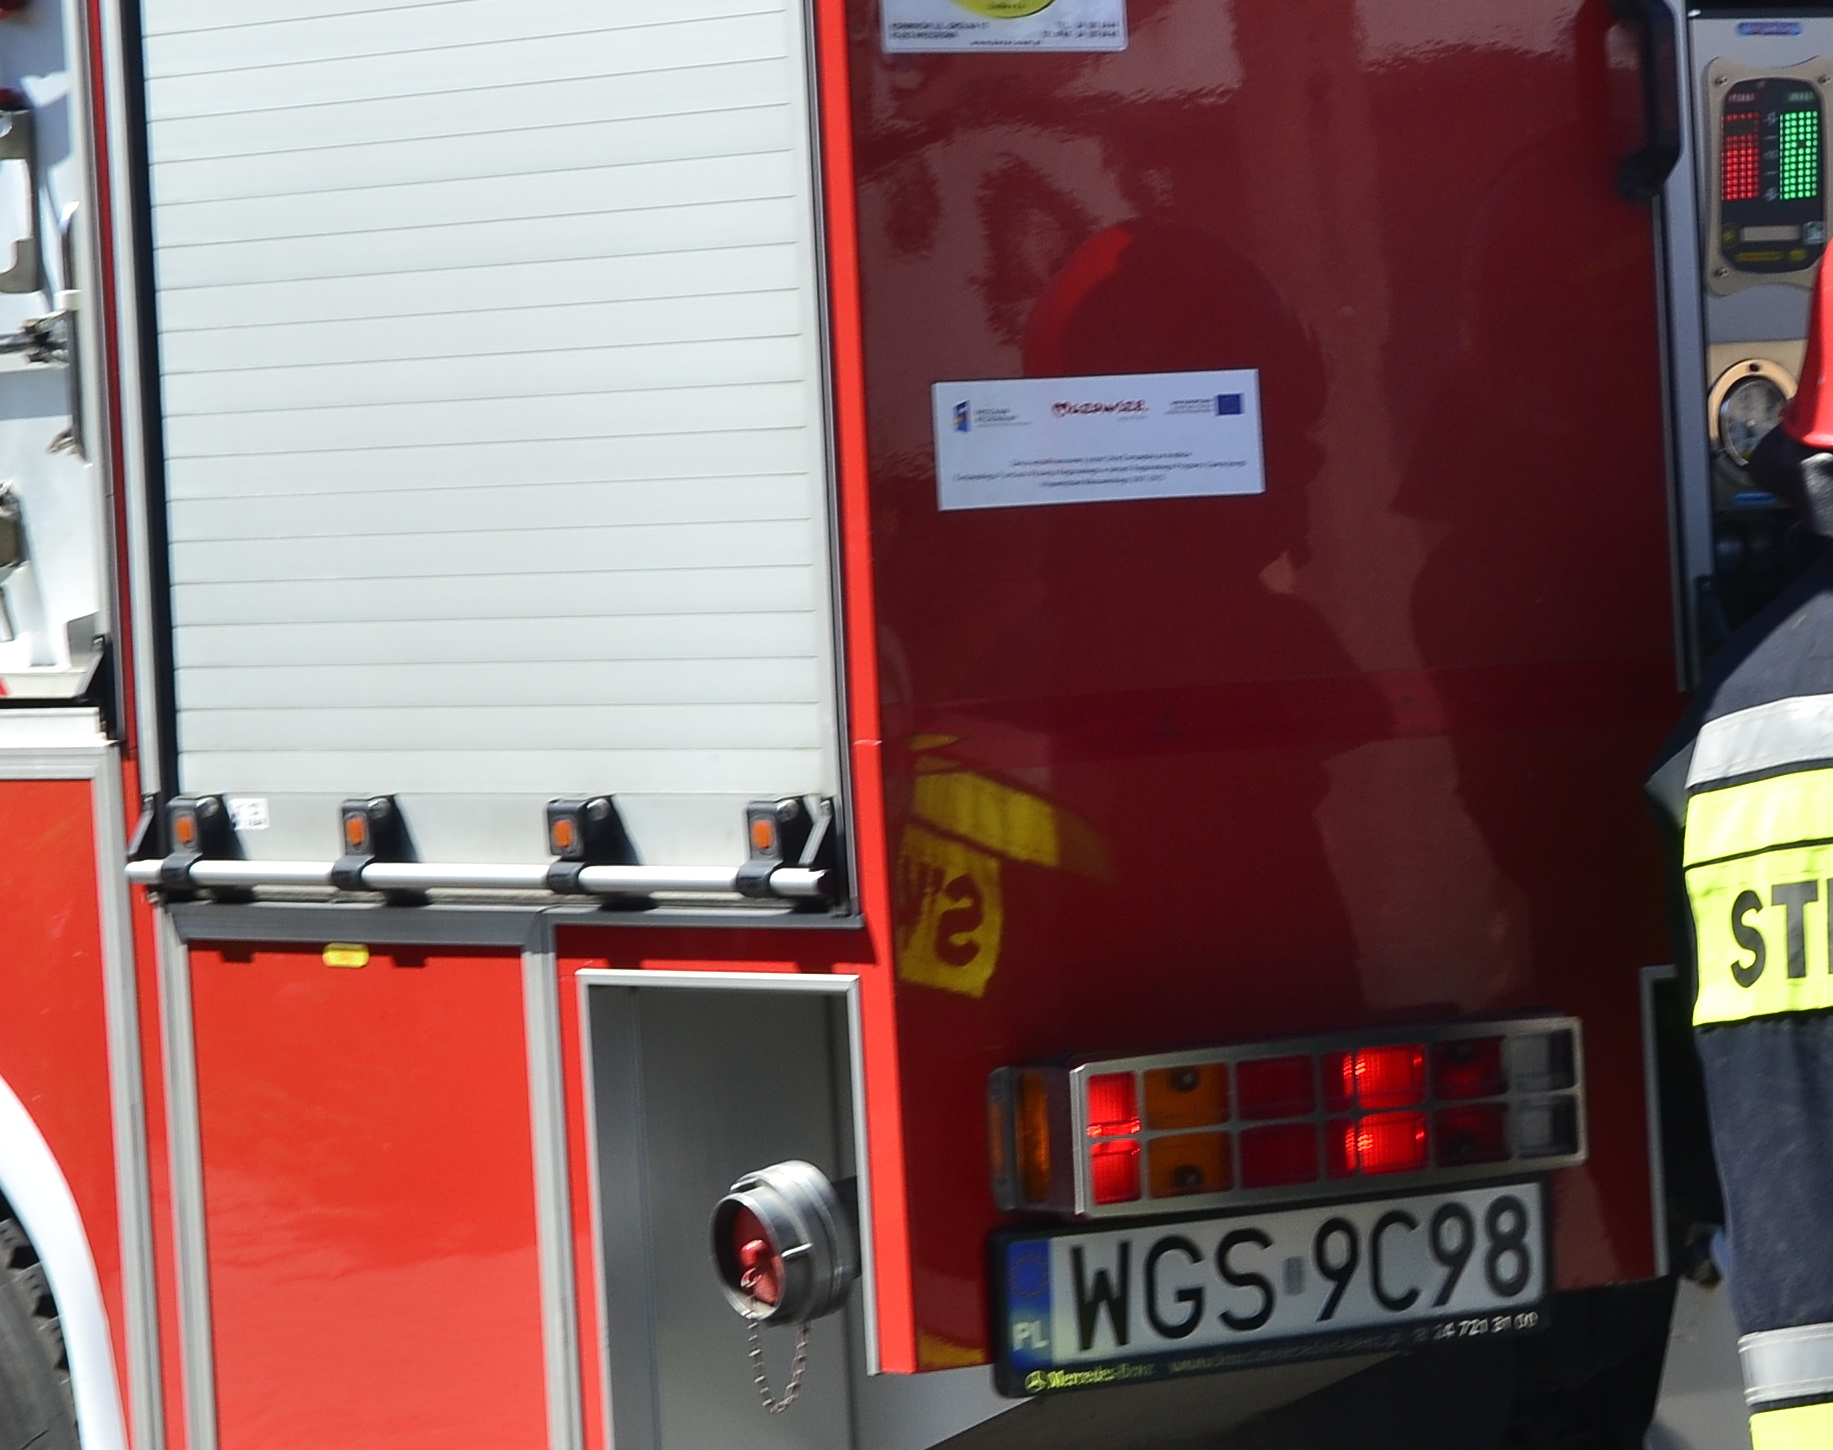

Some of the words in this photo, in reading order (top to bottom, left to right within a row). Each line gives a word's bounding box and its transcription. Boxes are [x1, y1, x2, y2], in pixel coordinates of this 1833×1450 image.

[1070, 1227, 1276, 1352] WGS
[1312, 1193, 1531, 1323] 9C98
[1011, 1320, 1051, 1352] PL
